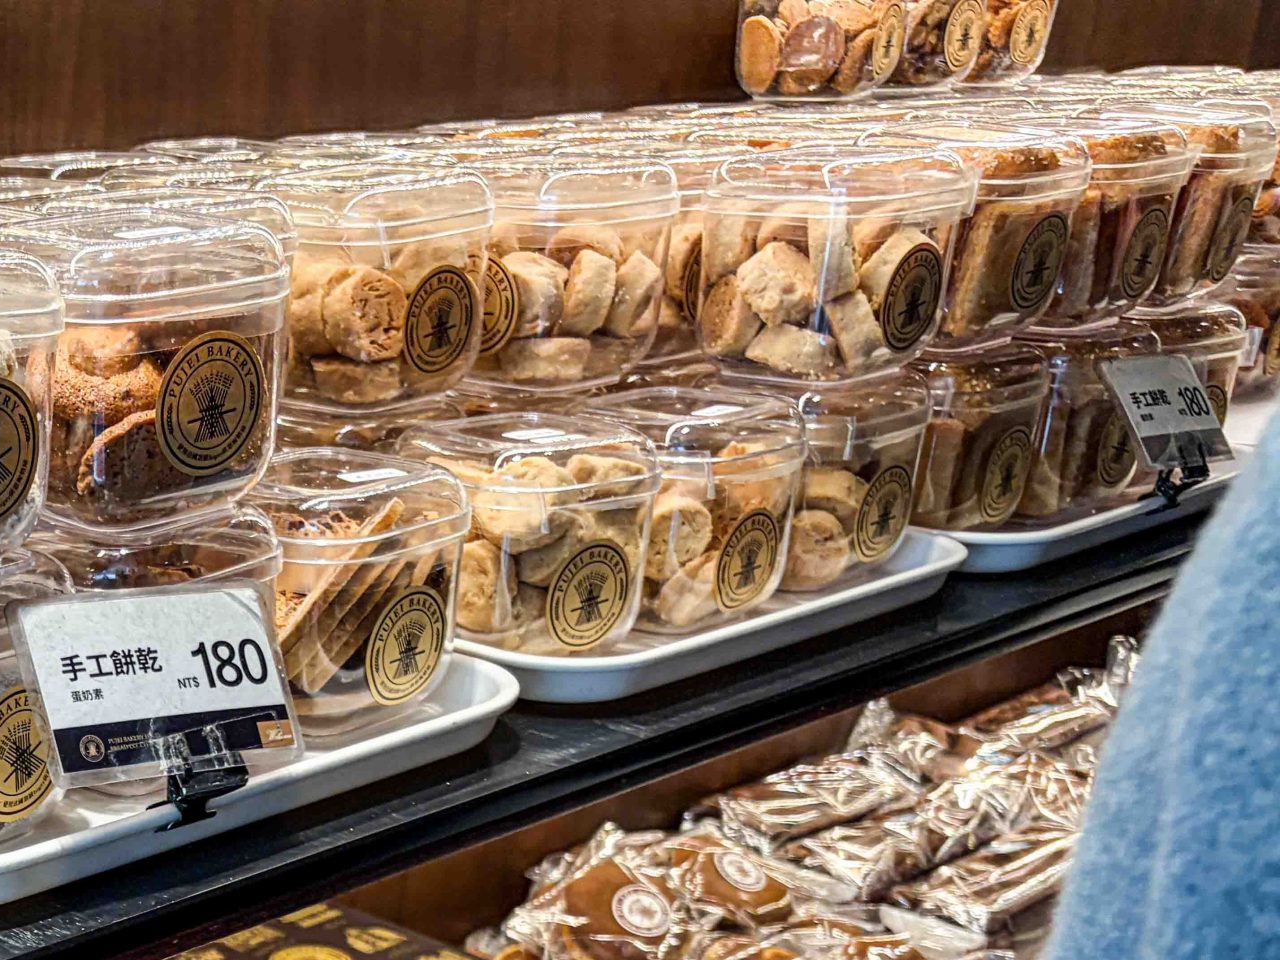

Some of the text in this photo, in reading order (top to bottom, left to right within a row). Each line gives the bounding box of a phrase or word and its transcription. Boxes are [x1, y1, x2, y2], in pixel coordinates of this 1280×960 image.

[169, 345, 253, 398] PUJEI BAKERY
[1177, 386, 1210, 417] 180
[409, 598, 440, 624] BAKERY
[60, 646, 163, 682] 手工餅乾
[177, 638, 268, 689] NT$ 180
[70, 688, 105, 703] 蛋奶素
